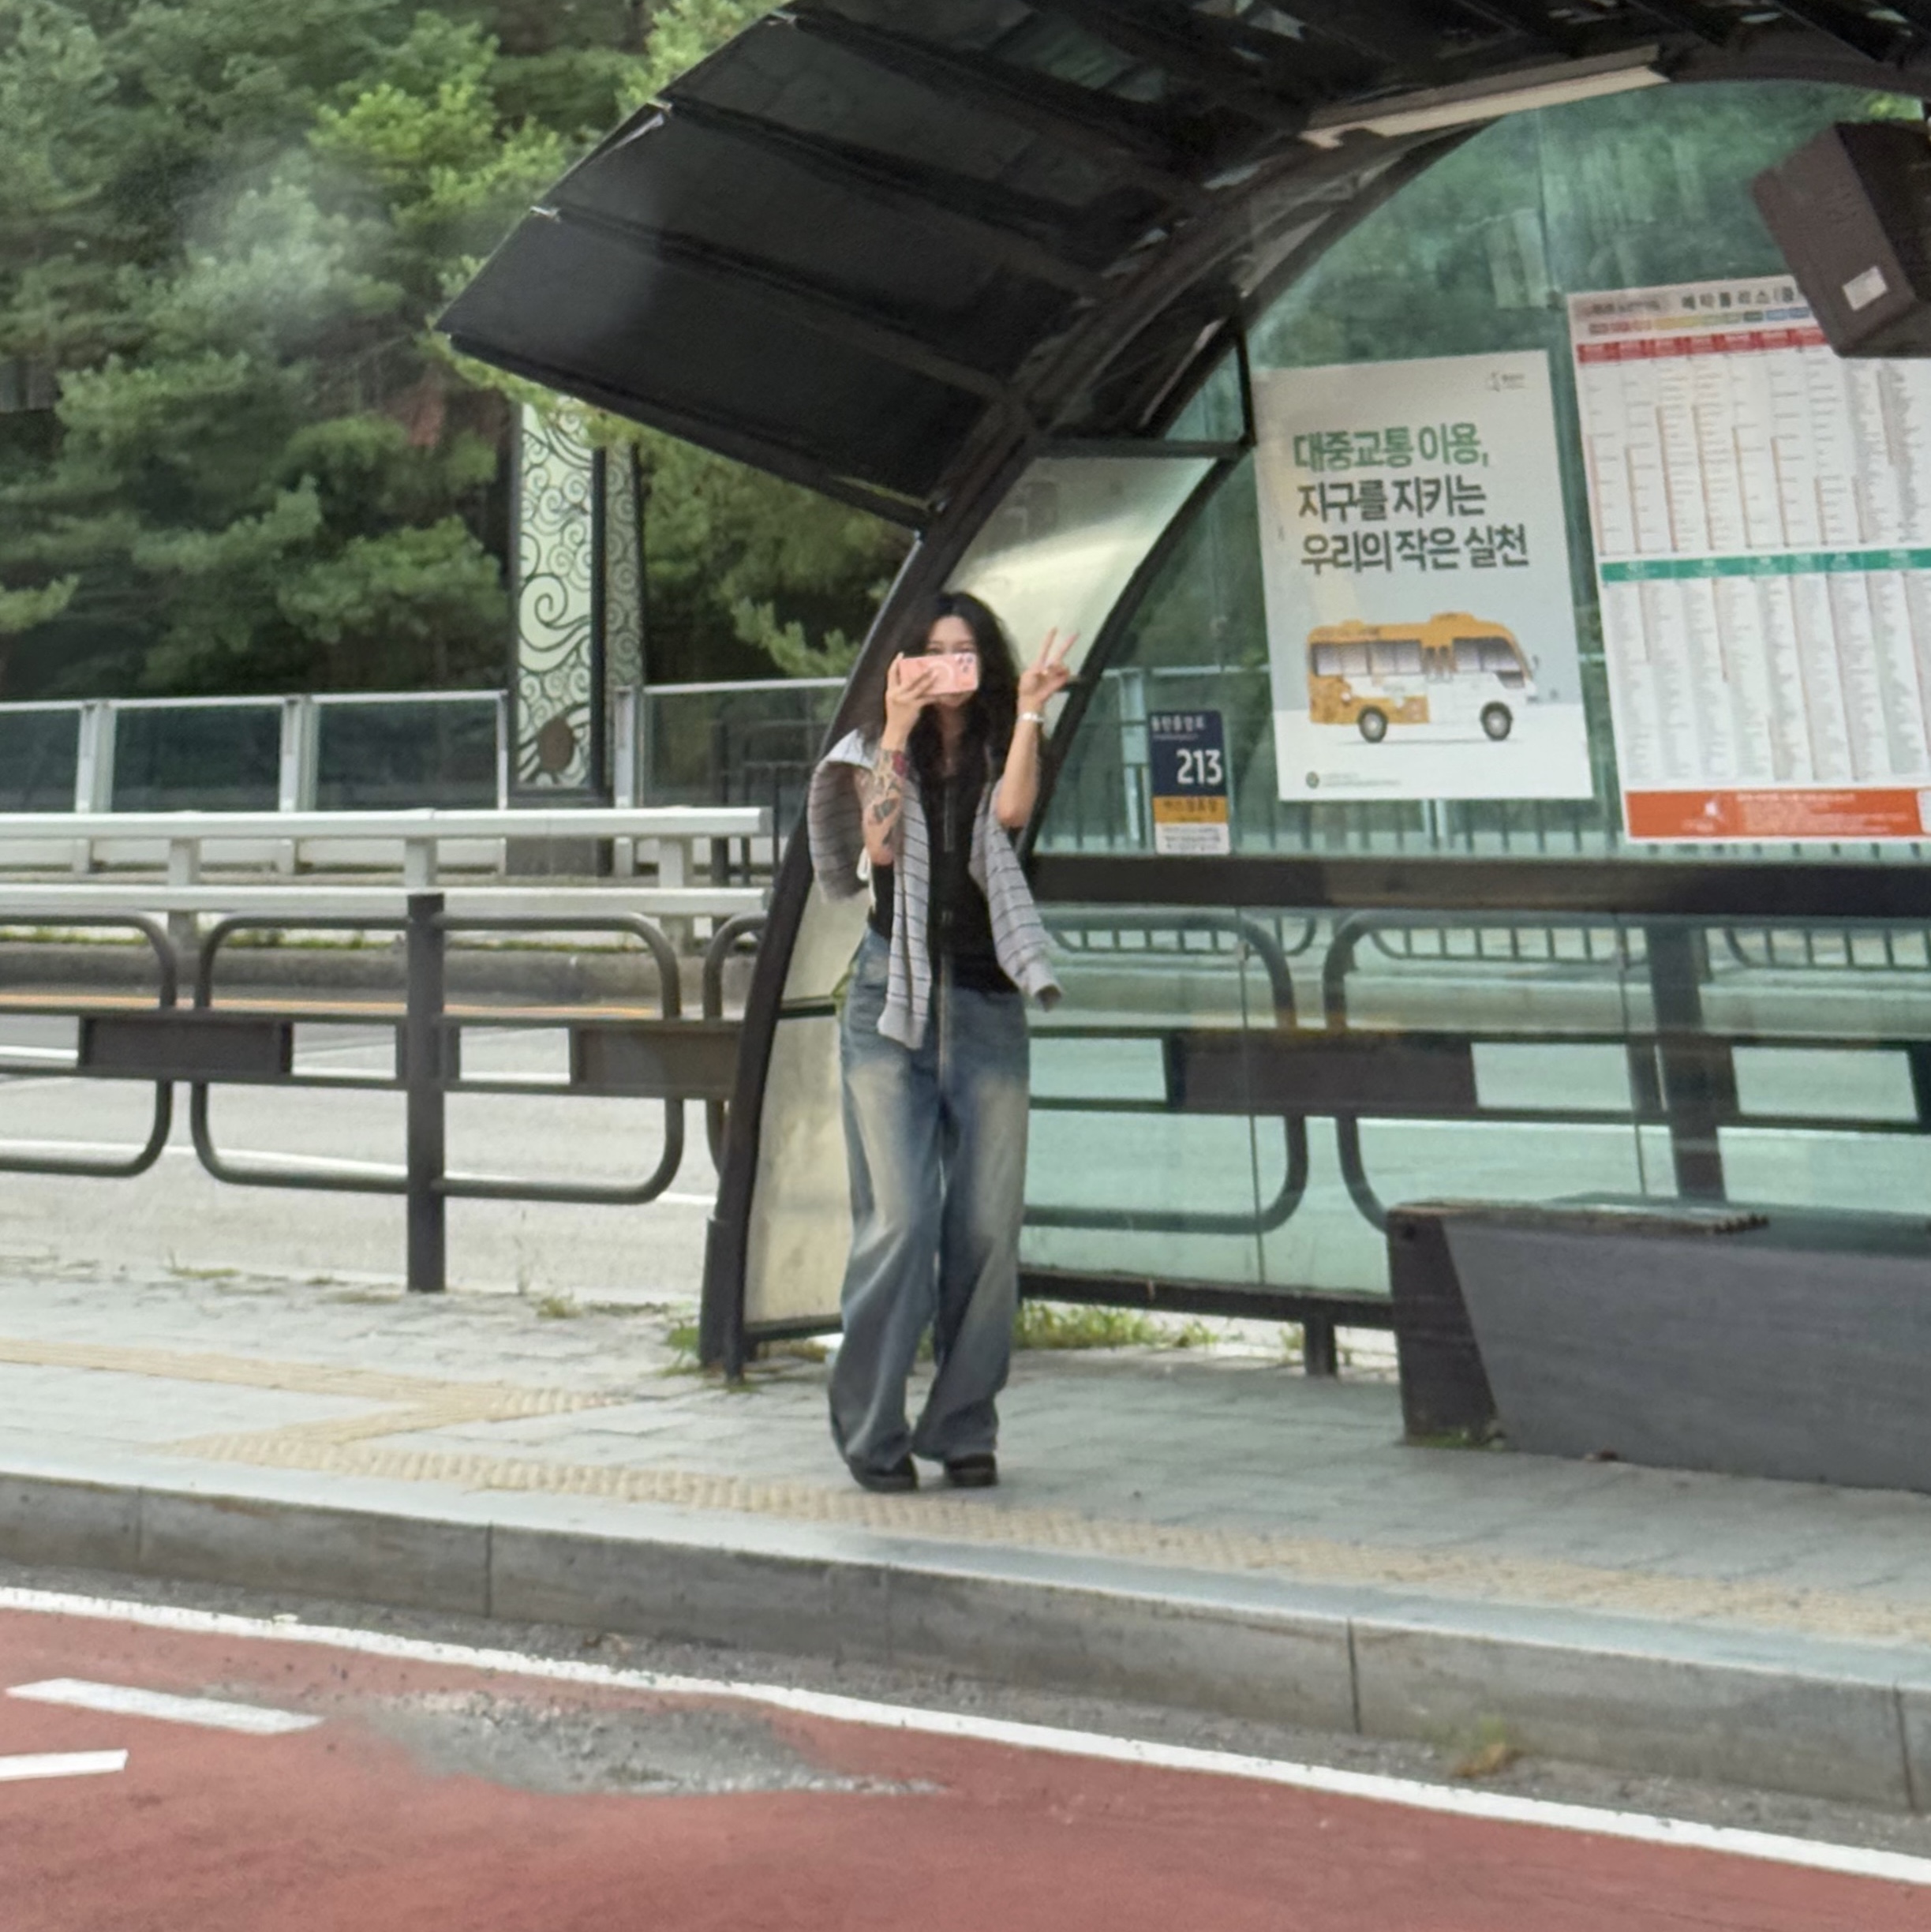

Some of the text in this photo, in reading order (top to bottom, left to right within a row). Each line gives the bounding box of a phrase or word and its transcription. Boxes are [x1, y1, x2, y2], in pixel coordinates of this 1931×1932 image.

[1293, 421, 1489, 472] 대중교통 이용,
[1297, 475, 1486, 523] 지구를 지키는
[1300, 523, 1529, 575] 우리의 작은 실천
[1176, 748, 1222, 784] 213
